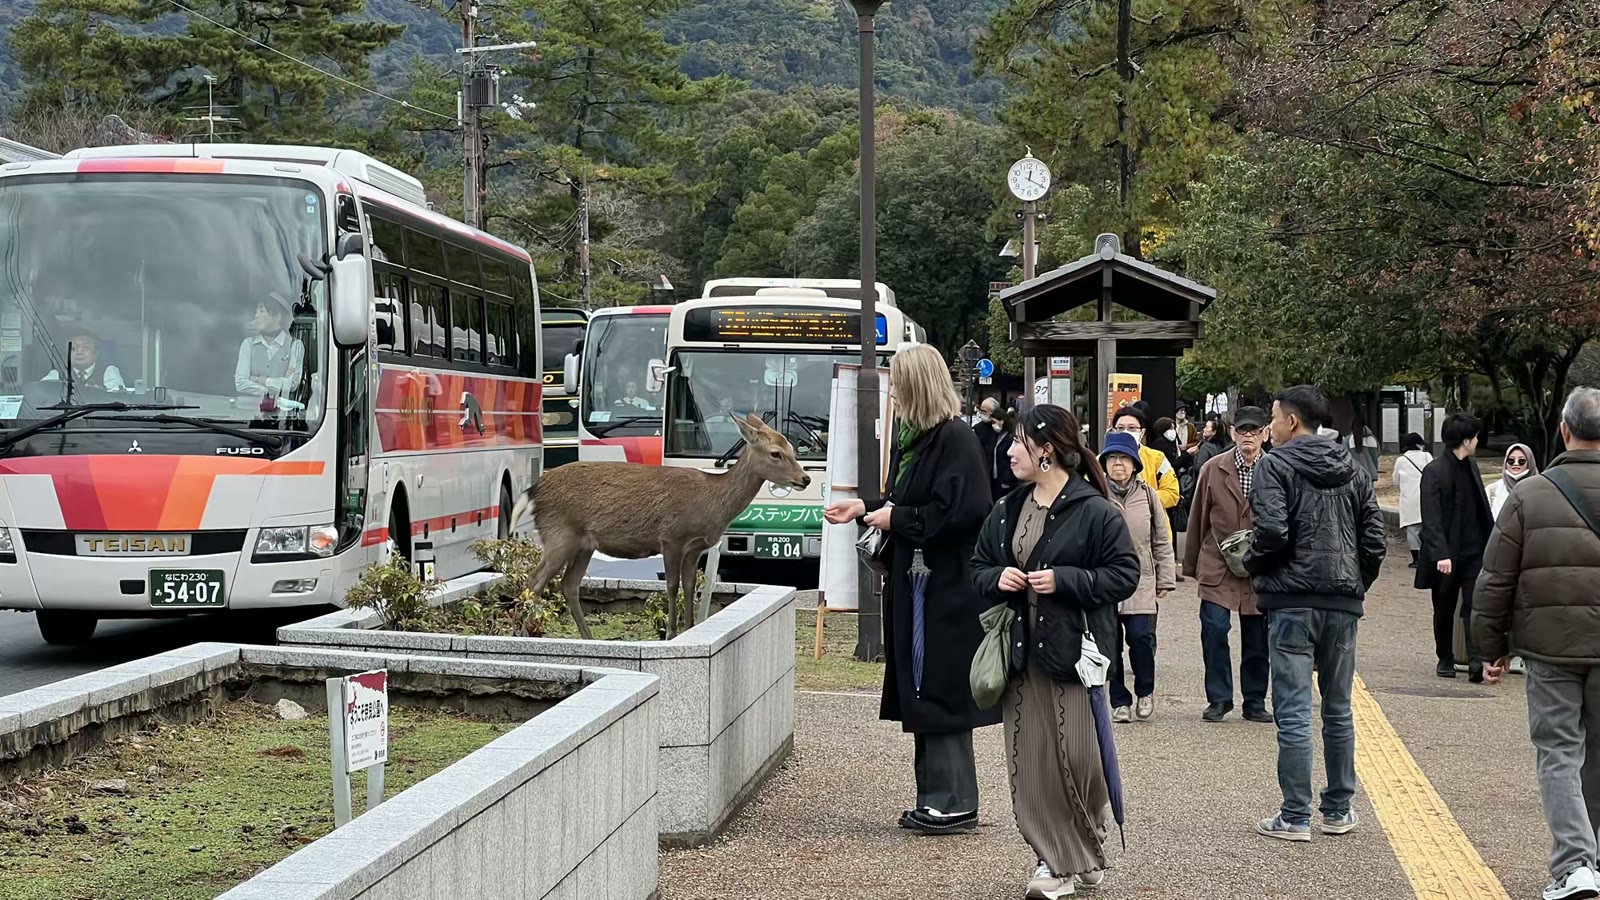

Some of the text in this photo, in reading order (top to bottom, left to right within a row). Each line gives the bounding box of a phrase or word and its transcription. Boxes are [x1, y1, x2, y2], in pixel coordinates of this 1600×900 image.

[216, 447, 265, 455] FUSO
[83, 537, 186, 553] TEISAN
[164, 573, 207, 581] なにわ230
[163, 581, 221, 603] 54-07
